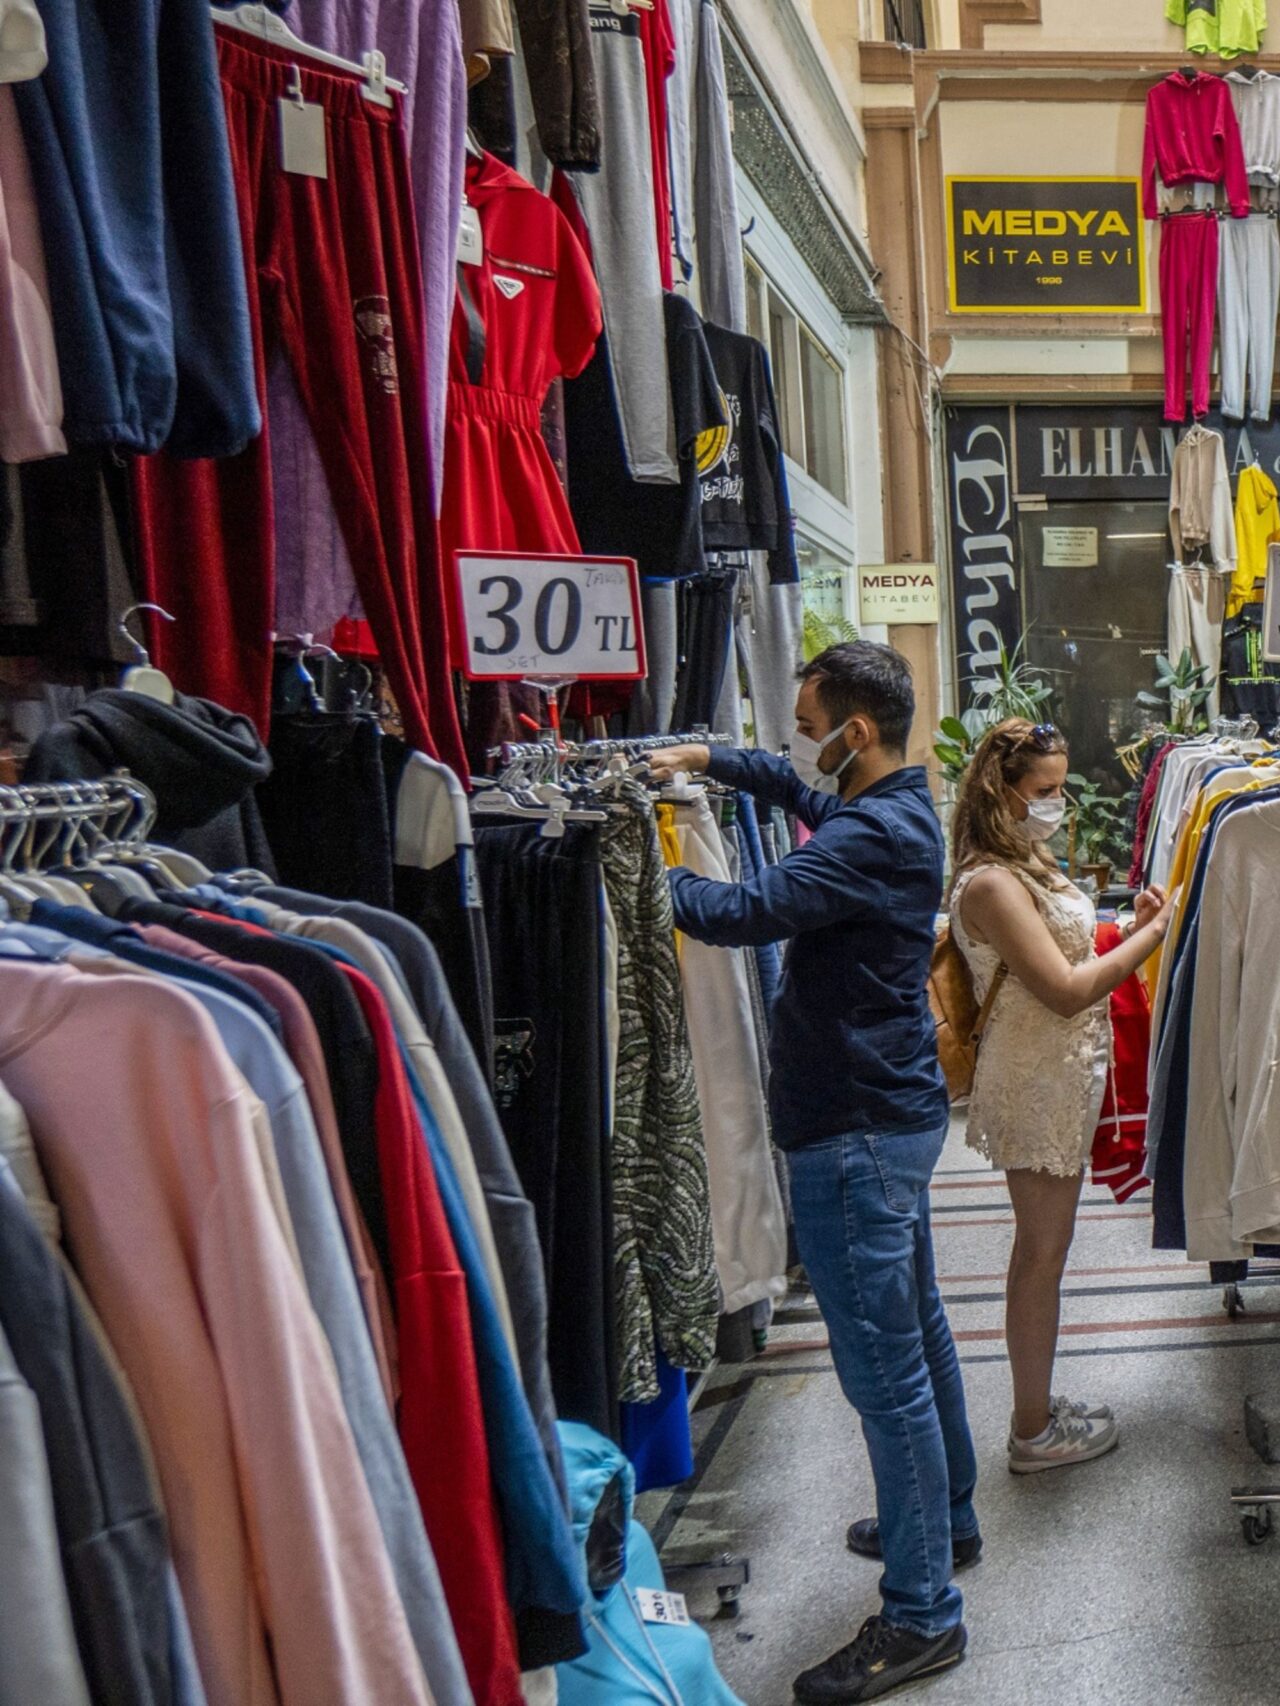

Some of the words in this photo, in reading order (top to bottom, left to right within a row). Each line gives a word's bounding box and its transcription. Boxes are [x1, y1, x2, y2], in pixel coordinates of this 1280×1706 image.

[962, 209, 1131, 237] MEDYA
[962, 246, 1133, 266] KİTABEVİ
[1039, 427, 1257, 477] ELHAMA
[862, 574, 935, 588] MEDYA
[473, 575, 582, 656] 30
[594, 615, 637, 652] TL
